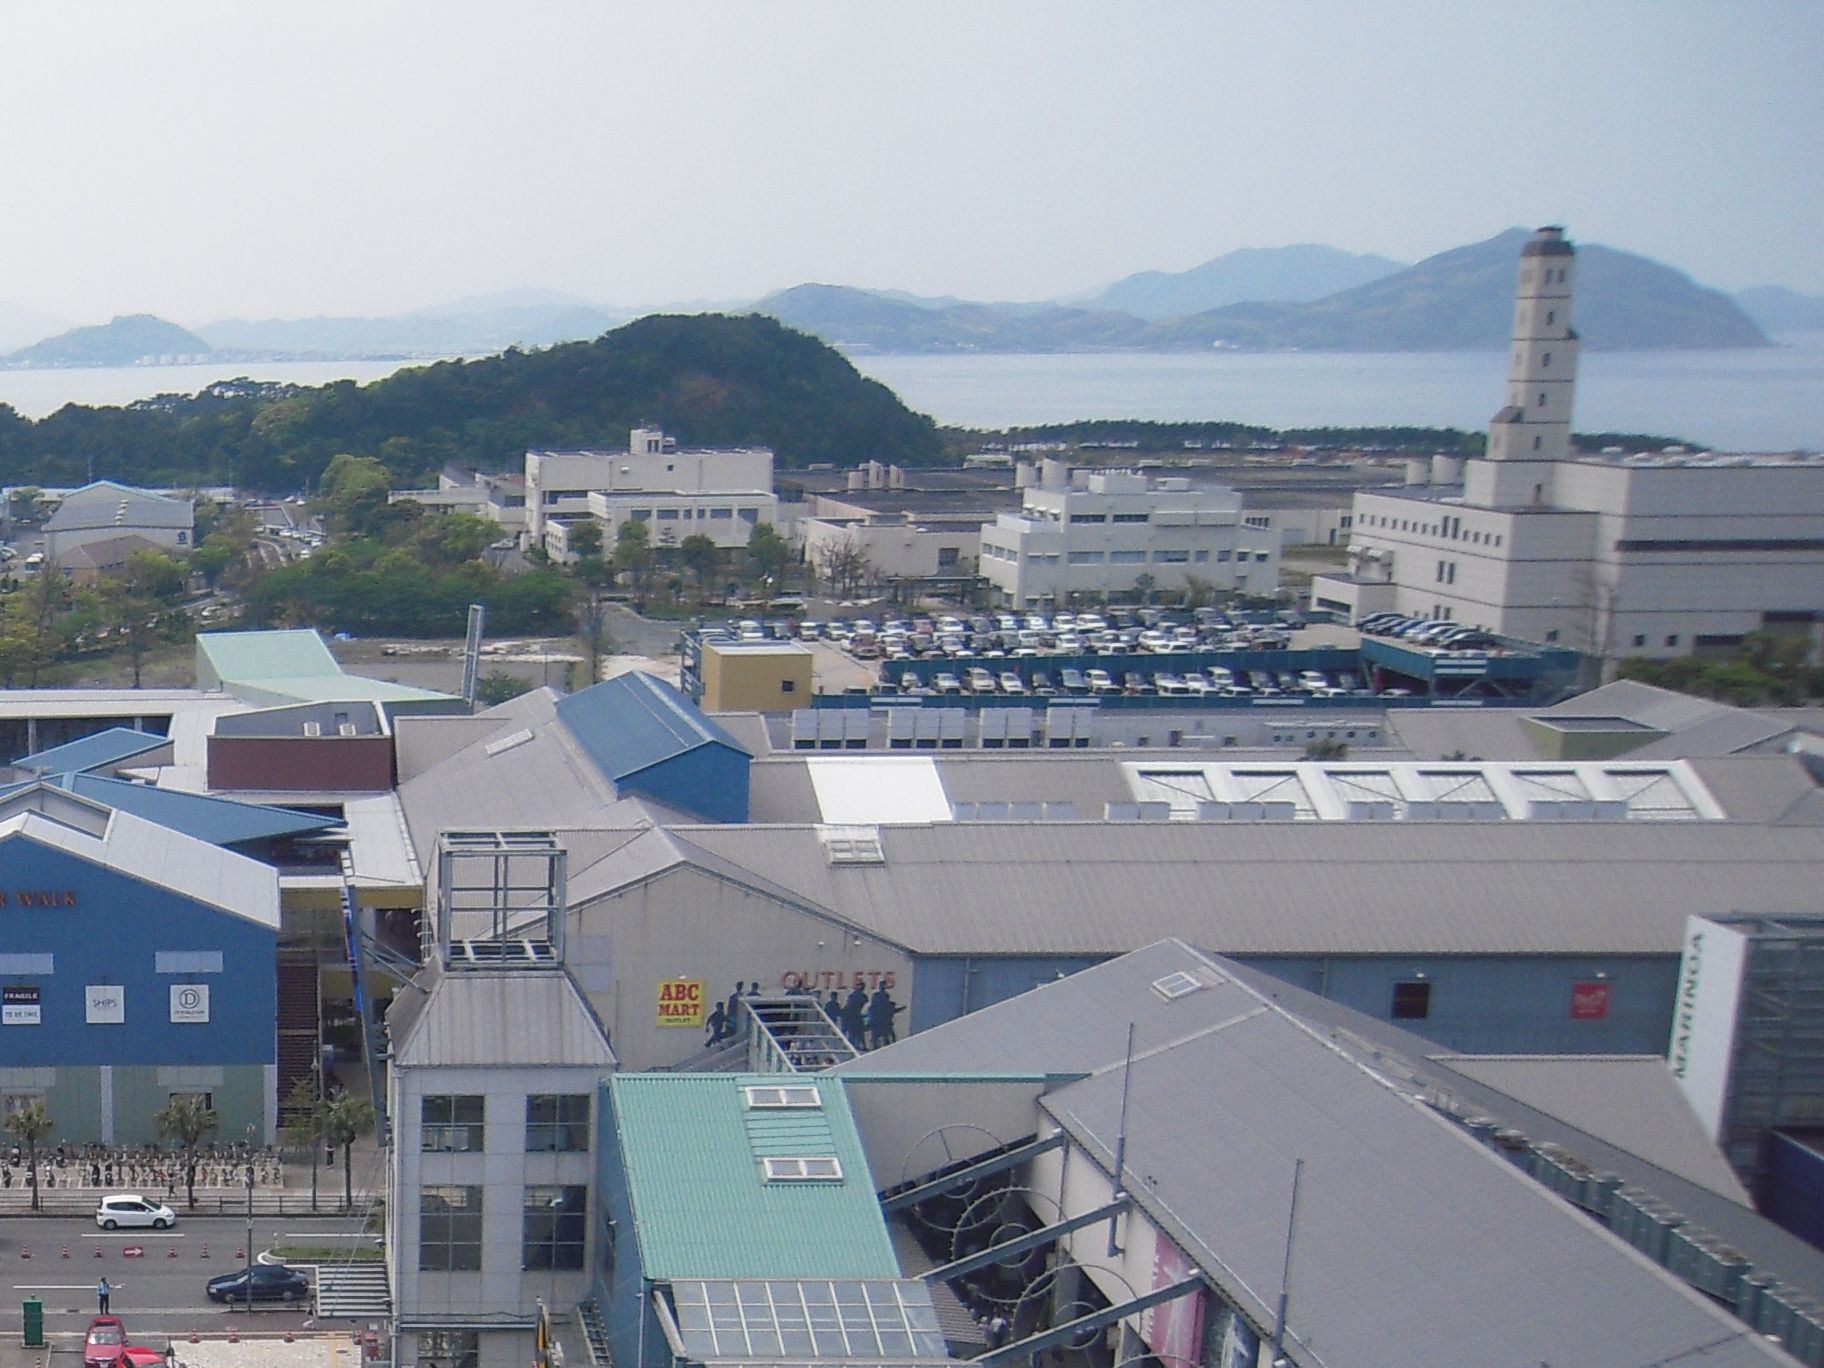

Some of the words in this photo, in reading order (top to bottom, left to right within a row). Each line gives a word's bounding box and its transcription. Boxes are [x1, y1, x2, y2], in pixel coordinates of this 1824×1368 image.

[16, 890, 77, 907] WALK
[780, 970, 896, 990] OUTLETS
[661, 983, 699, 1001] ABC
[658, 1003, 699, 1017] MART
